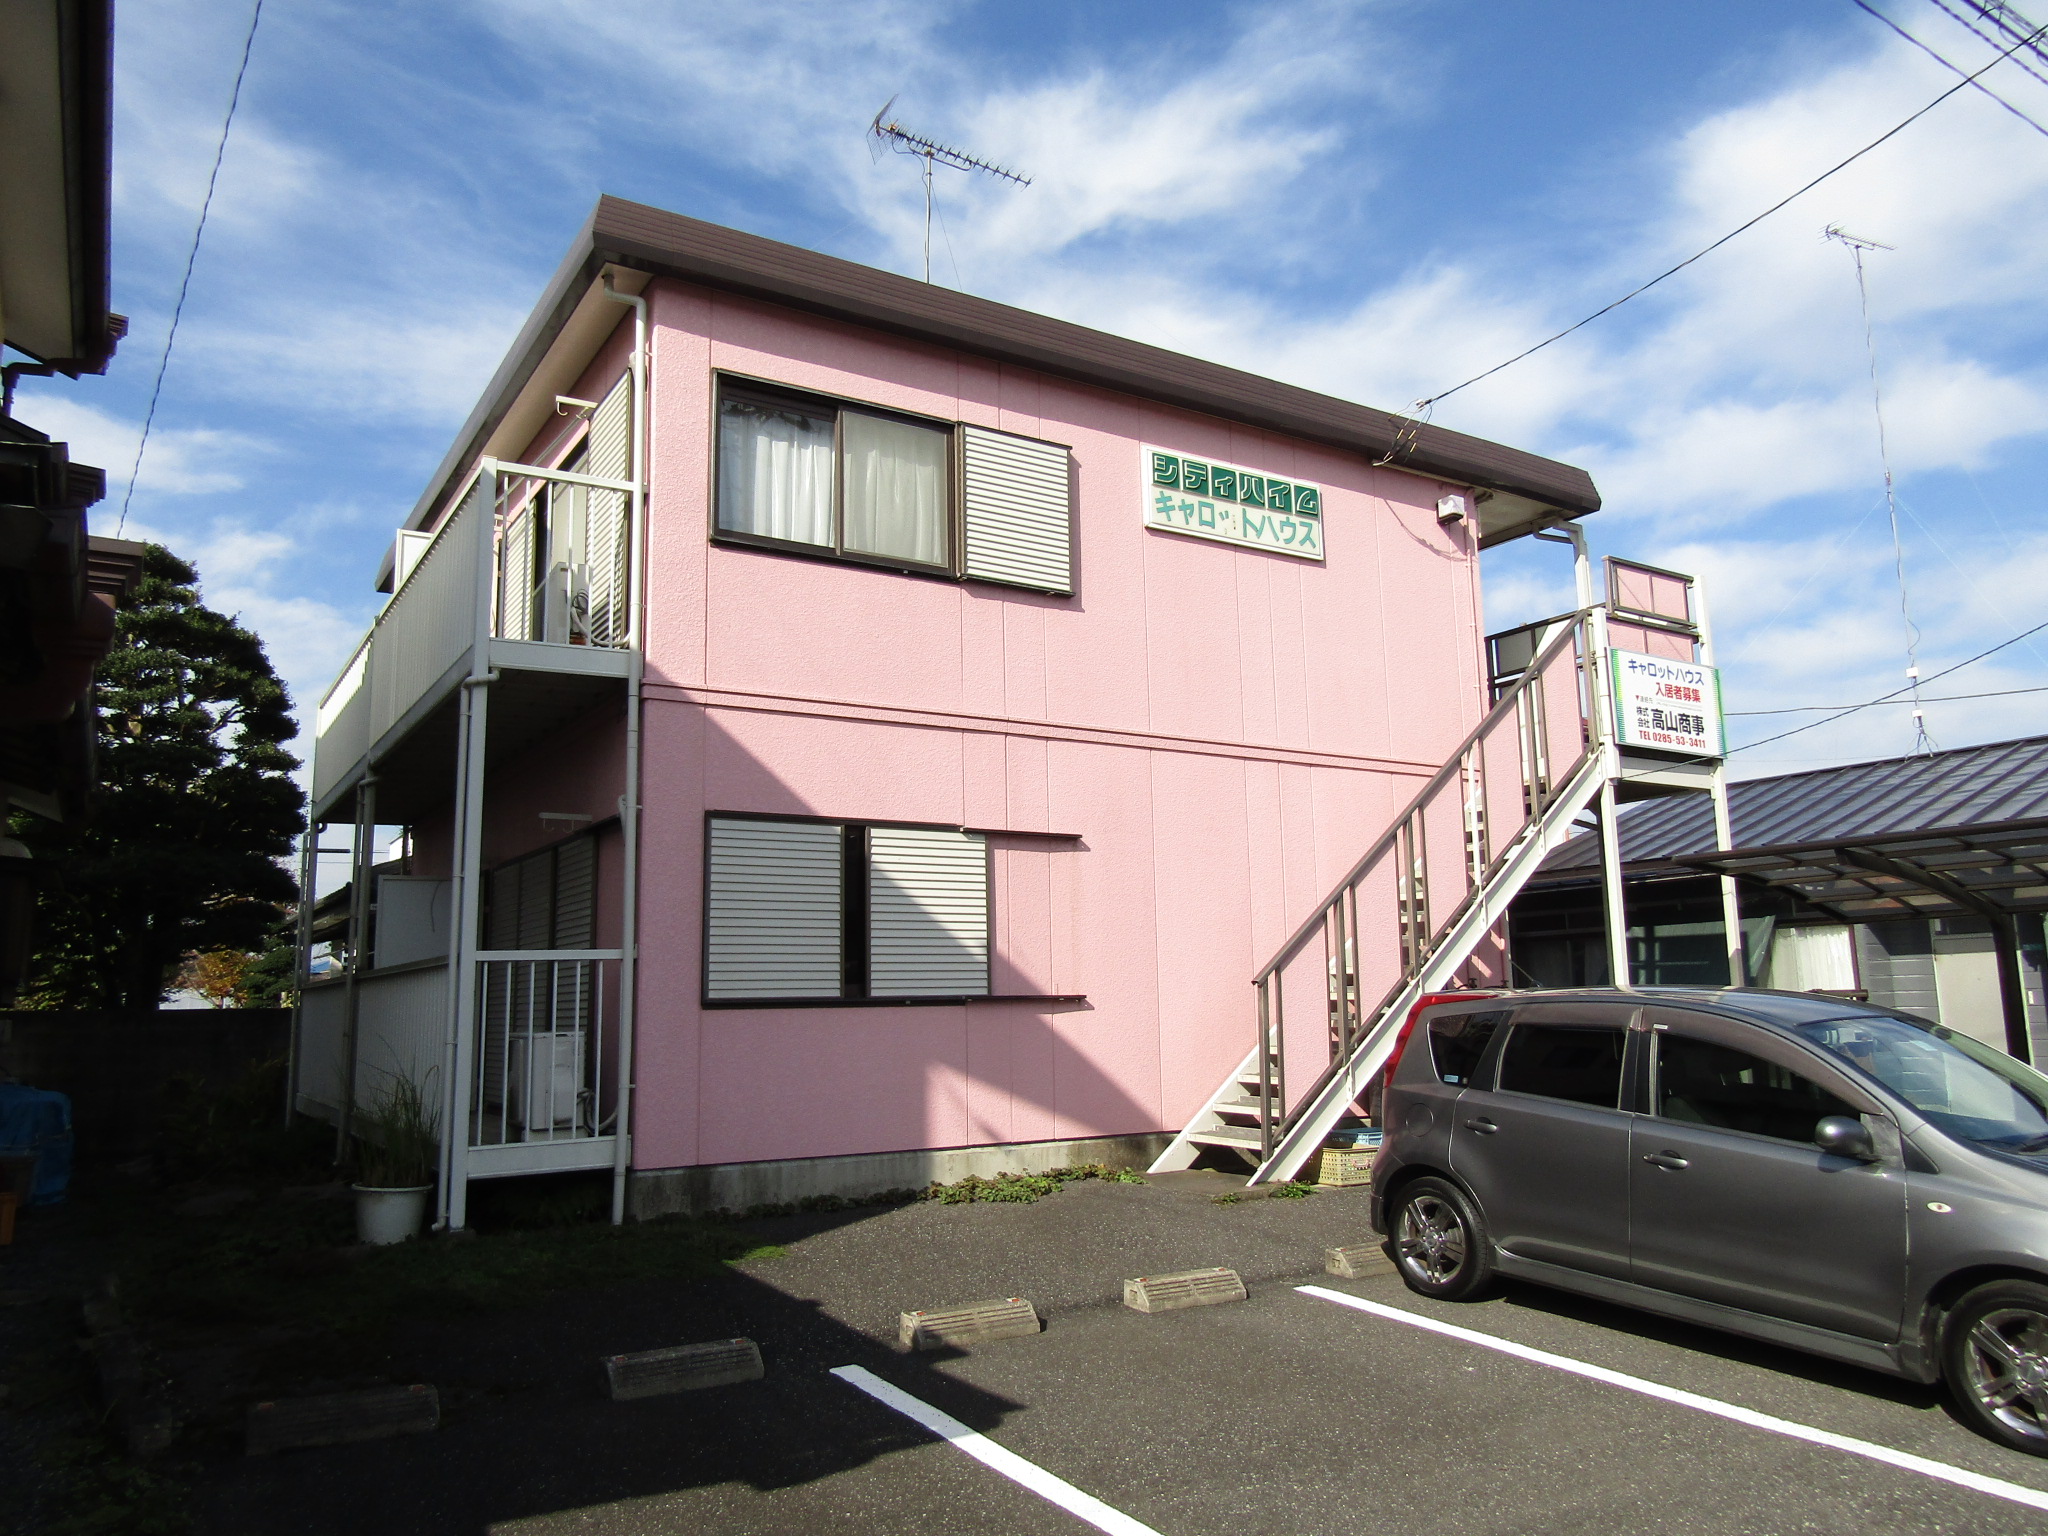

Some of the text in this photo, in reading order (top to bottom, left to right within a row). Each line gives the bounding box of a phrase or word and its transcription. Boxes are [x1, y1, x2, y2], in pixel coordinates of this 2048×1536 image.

[1153, 454, 1318, 515] シティハイム
[1628, 658, 1704, 685] キャロットハウス
[1655, 682, 1702, 703] 入居者募集
[1650, 708, 1705, 736] 高山商事
[1639, 730, 1706, 748] TEL 0285-53-3411
